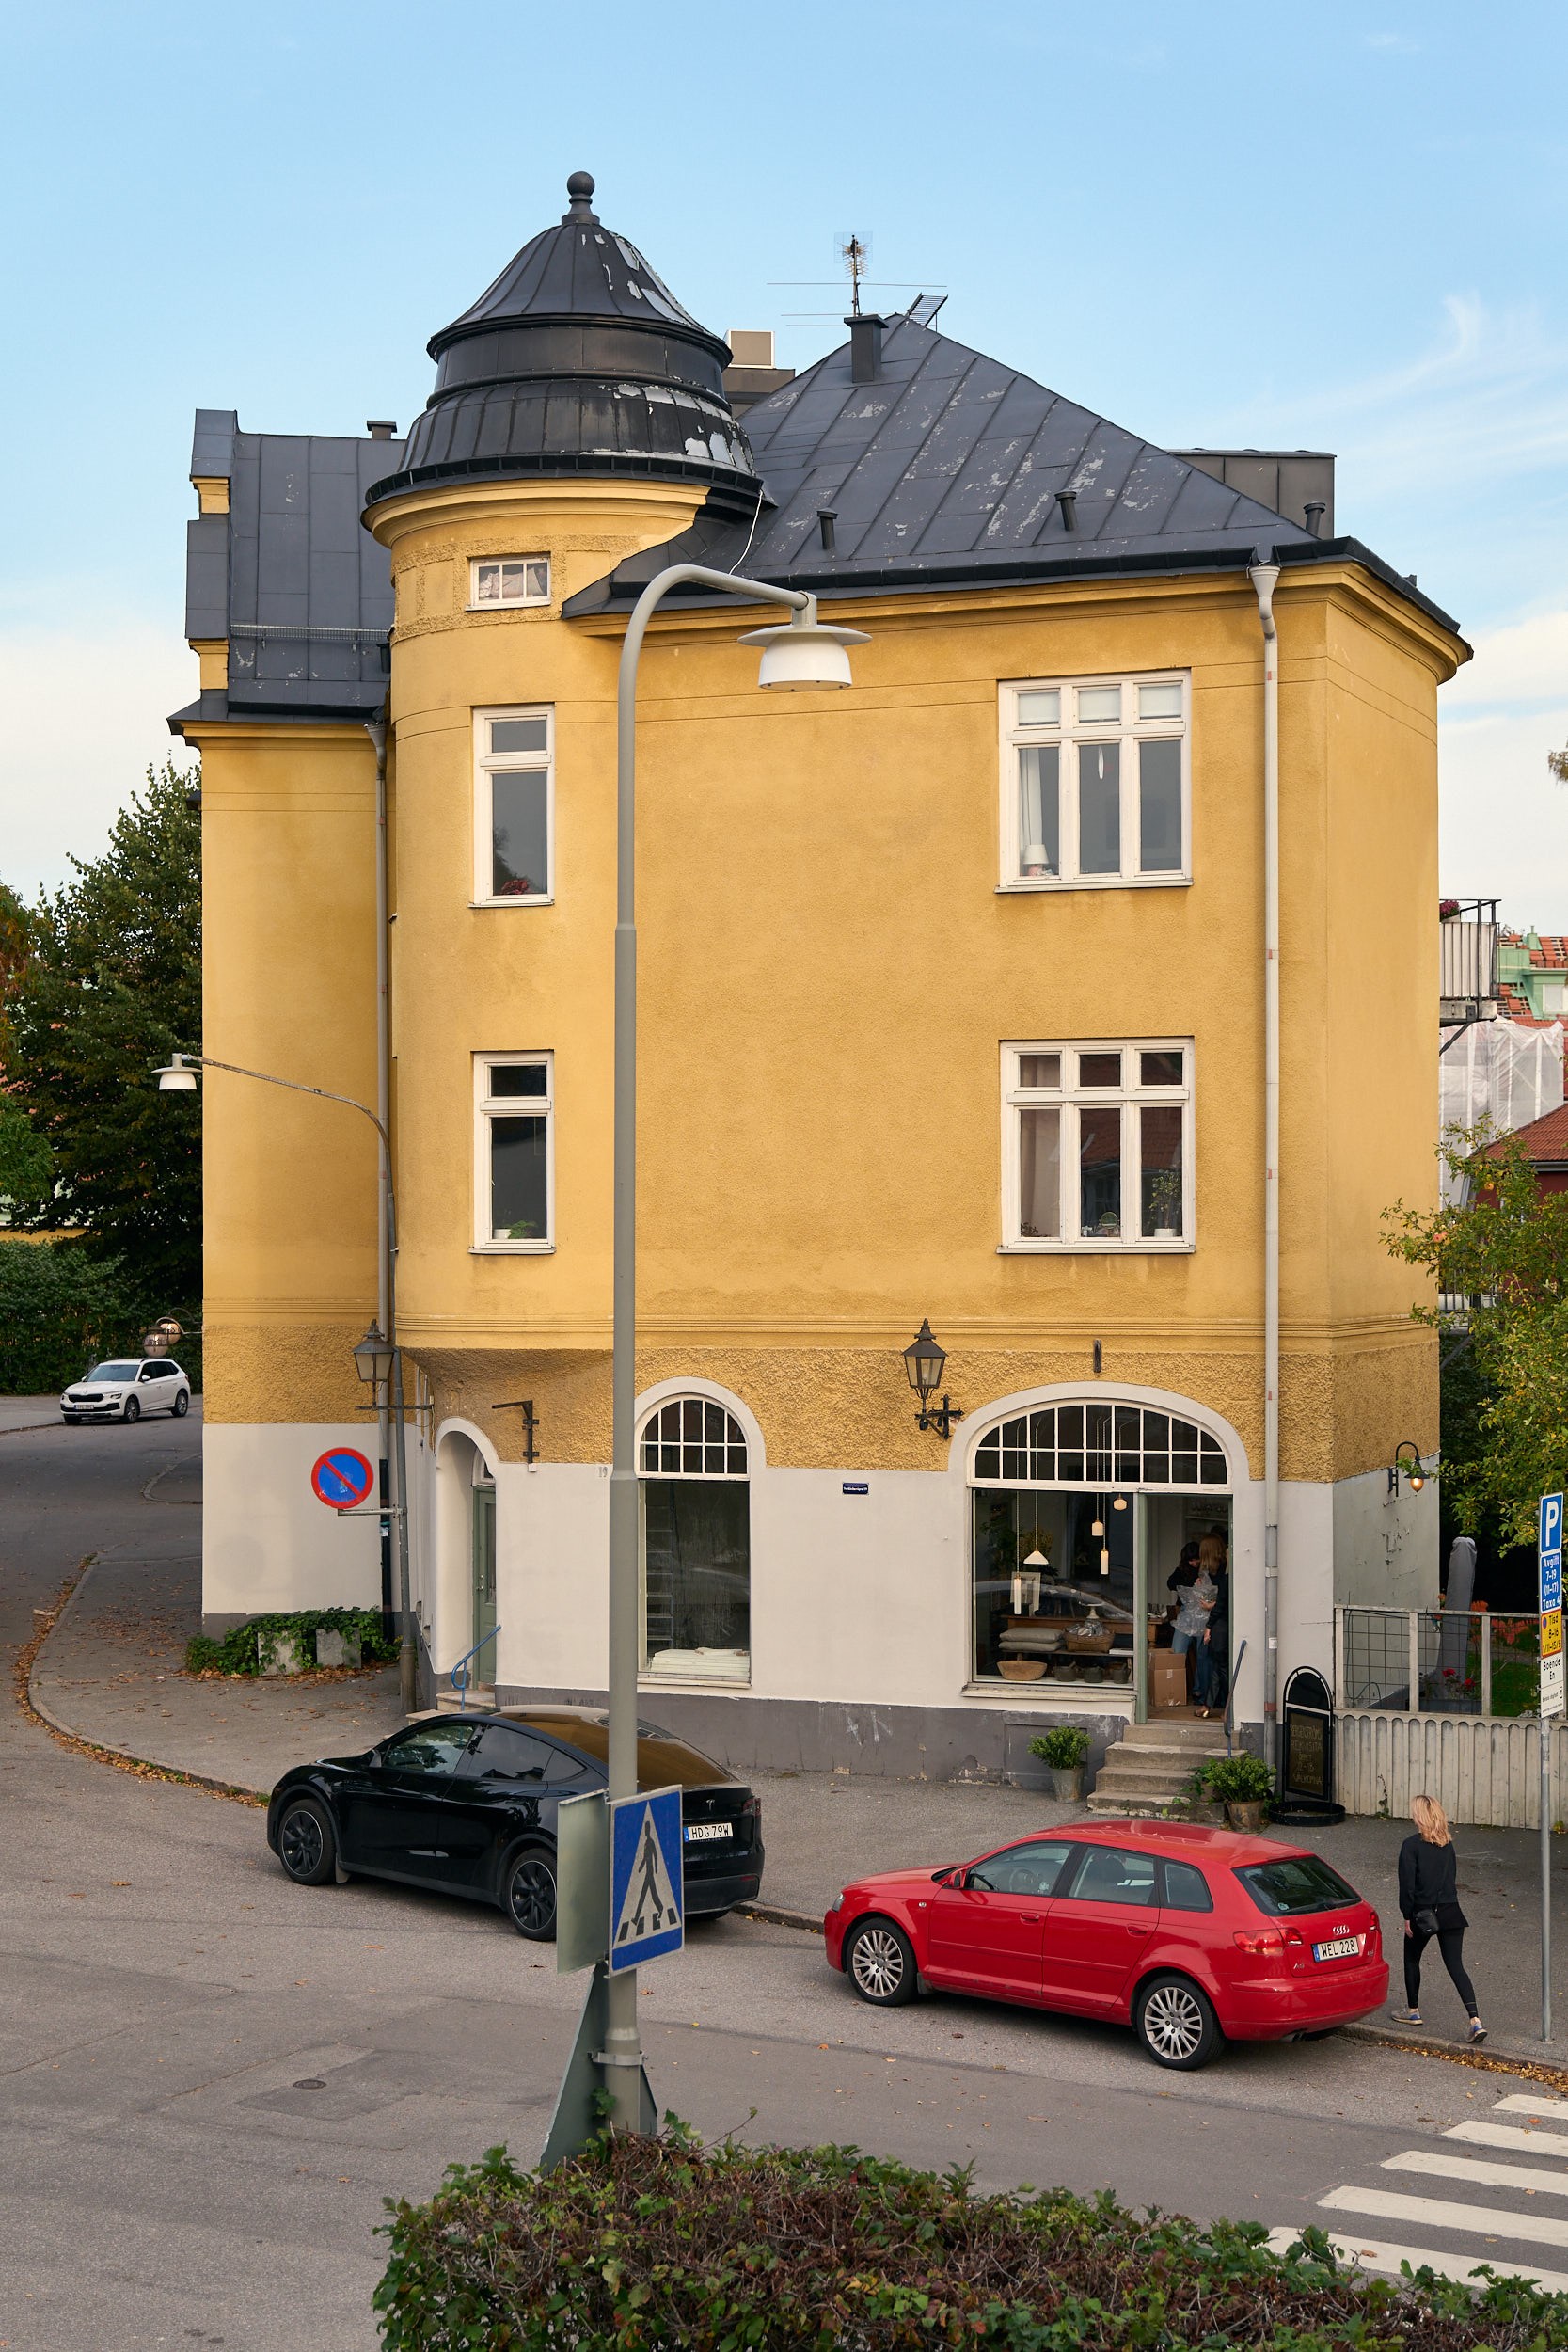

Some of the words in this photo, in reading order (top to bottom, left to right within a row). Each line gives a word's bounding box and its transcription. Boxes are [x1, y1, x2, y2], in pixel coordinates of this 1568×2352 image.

[1545, 1501, 1560, 1548] P
[1543, 1555, 1560, 1568] Avgift
[1545, 1569, 1557, 1581] 7-19
[1544, 1581, 1559, 1597] (11-17)
[1543, 1598, 1556, 1610] Taxa
[1548, 1613, 1559, 1625] Tisd
[1543, 1657, 1560, 1671] Boende
[691, 1827, 709, 1838] HDG
[711, 1825, 729, 1836] 79W
[1321, 1944, 1338, 1957] WEL
[1339, 1940, 1355, 1954] 228
